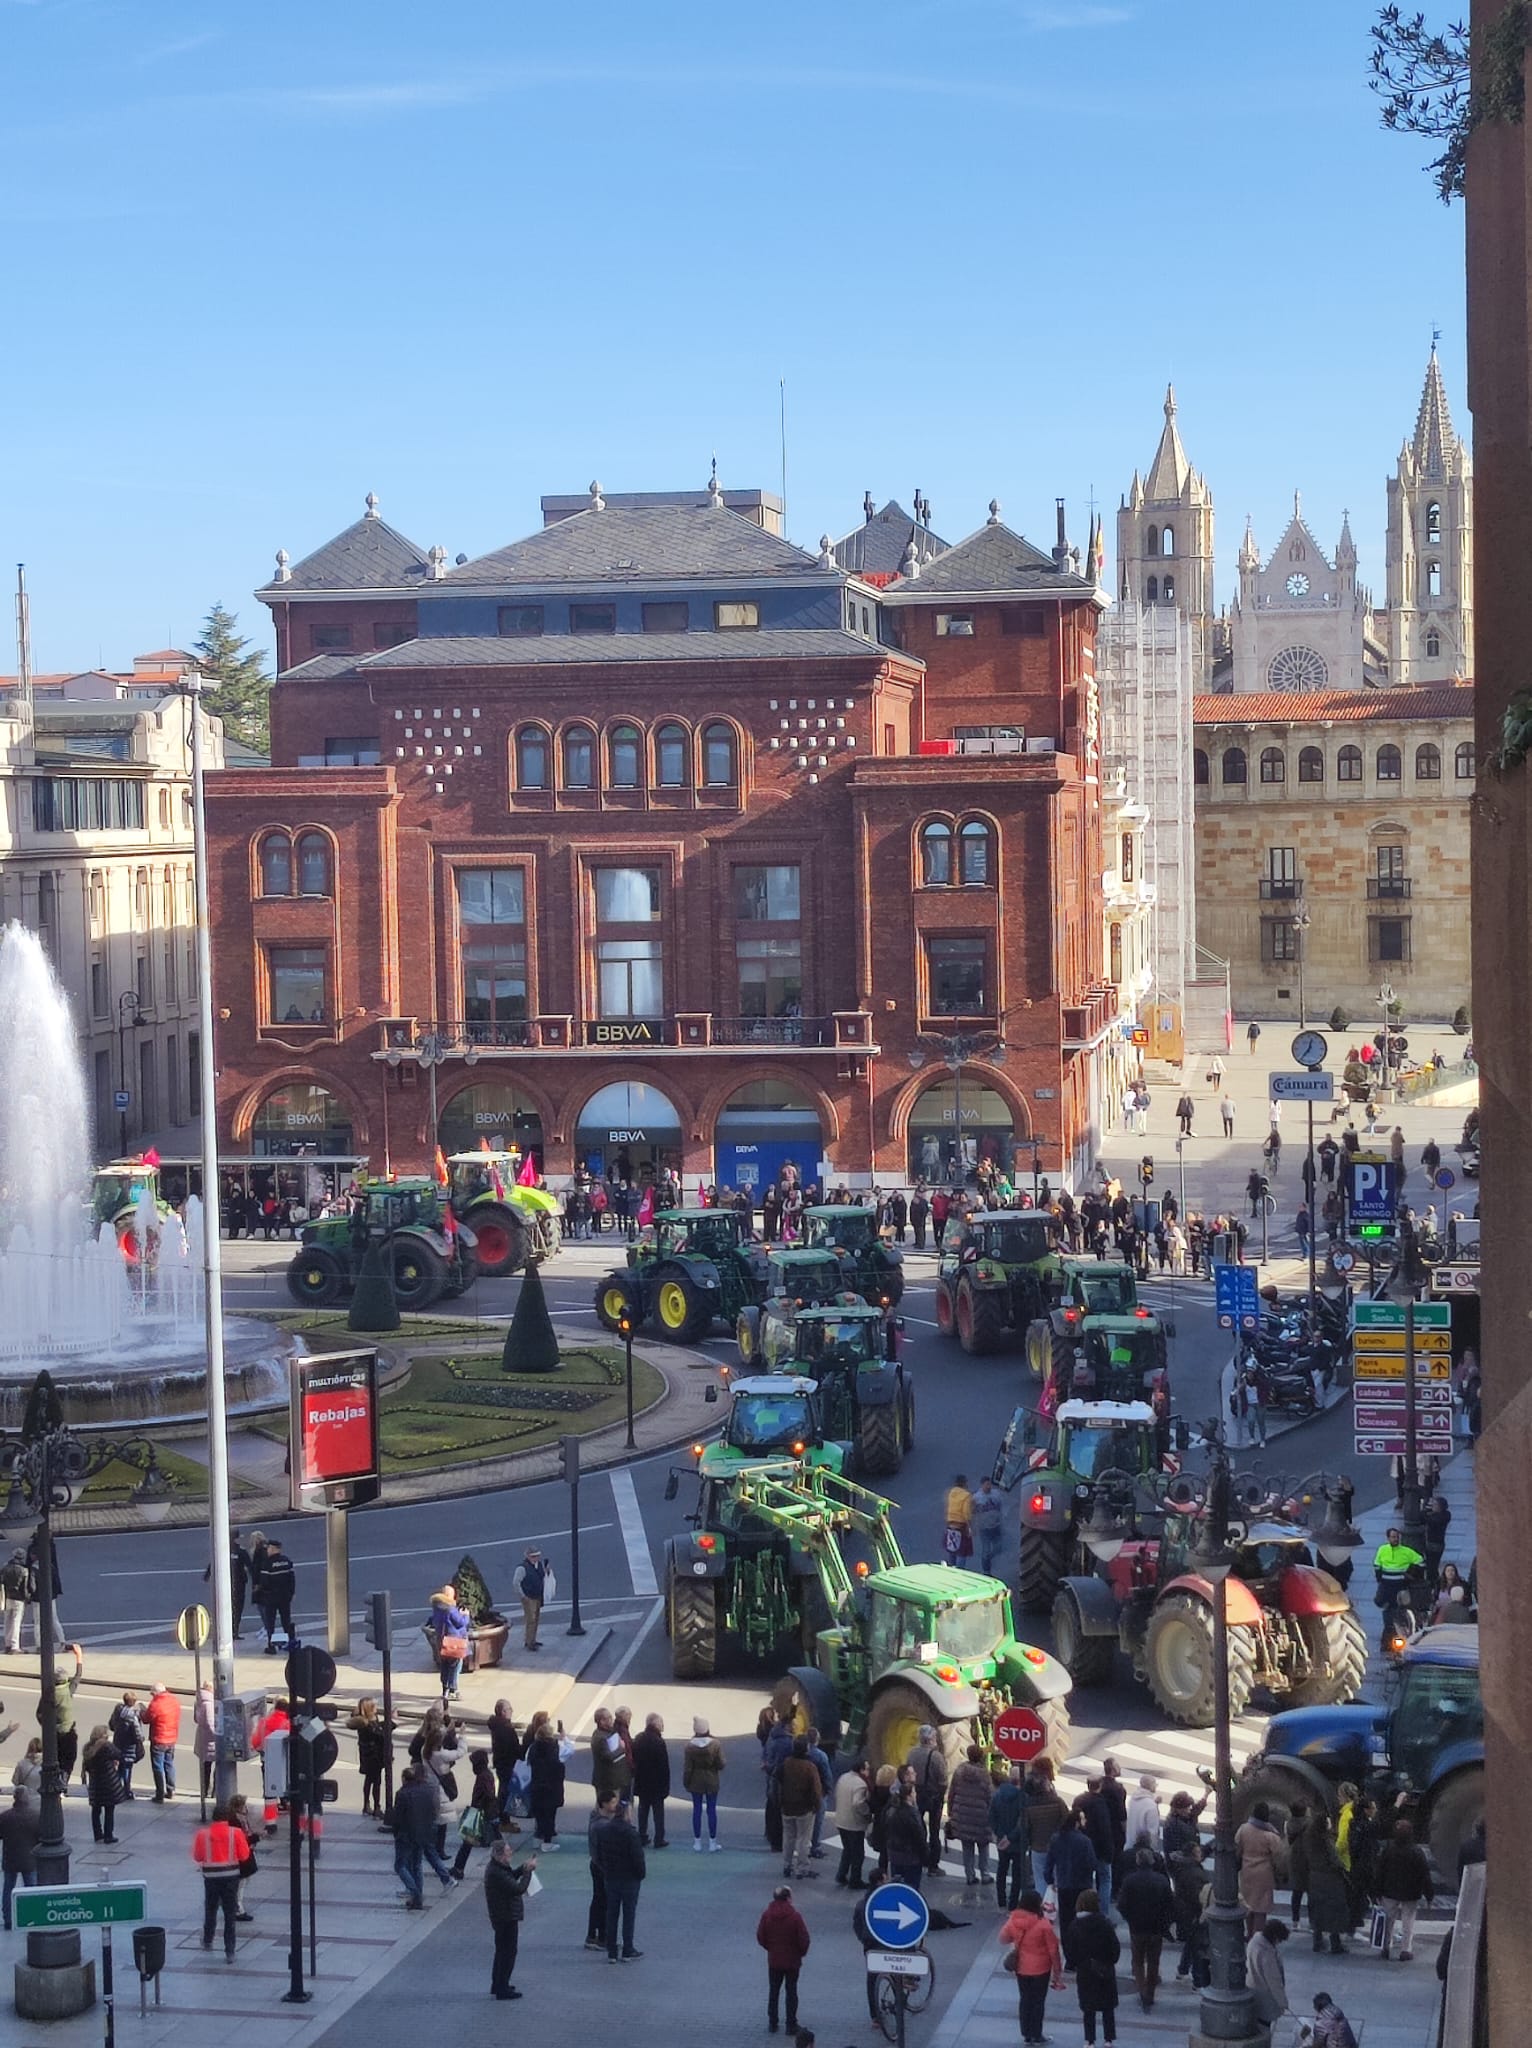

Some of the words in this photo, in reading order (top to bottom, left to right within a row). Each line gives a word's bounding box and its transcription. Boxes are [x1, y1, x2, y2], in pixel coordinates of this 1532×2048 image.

[597, 1023, 652, 1041] BBVA
[287, 1113, 323, 1125] BBVA
[475, 1112, 511, 1124] BBVA
[609, 1130, 645, 1143] BBVA
[735, 1145, 758, 1153] BBVA
[1354, 1164, 1377, 1201] P
[1371, 1314, 1394, 1322] Santo
[1398, 1314, 1433, 1323] Dmingo
[1358, 1388, 1390, 1397] catedral
[309, 1405, 366, 1424] Rebajas
[1359, 1417, 1398, 1426] Diocesano
[998, 1726, 1042, 1742] STOP
[46, 1895, 82, 1907] avenida
[47, 1907, 94, 1922] Ordoño
